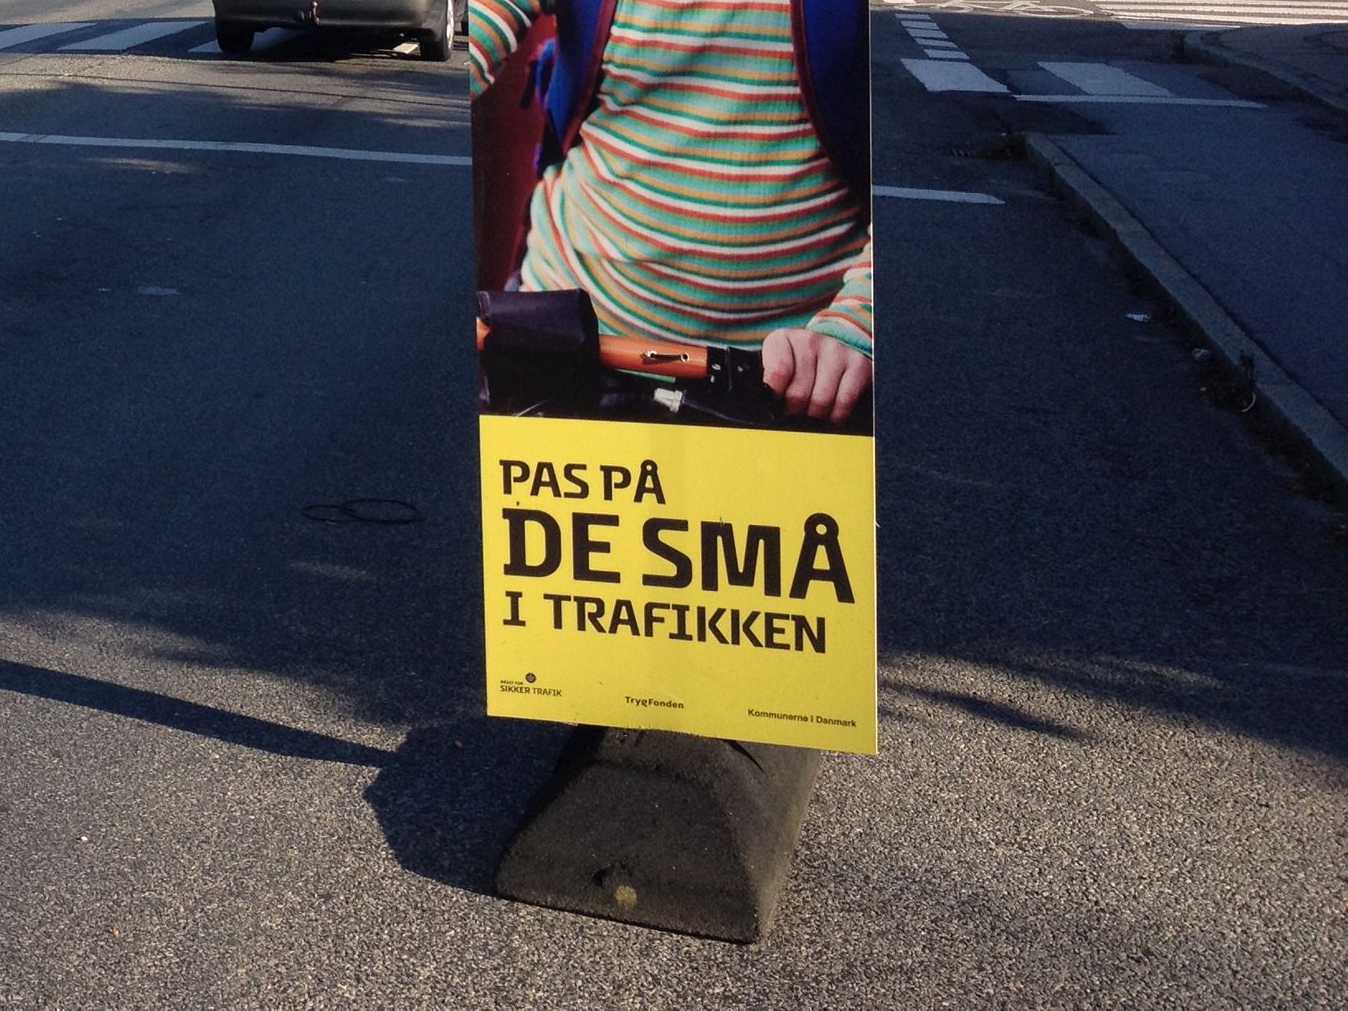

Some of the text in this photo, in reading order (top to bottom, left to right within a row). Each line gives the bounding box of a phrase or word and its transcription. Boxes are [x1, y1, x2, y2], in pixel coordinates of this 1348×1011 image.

[499, 459, 666, 505] PAS PÅ
[502, 507, 856, 604] DE SMÅ
[503, 590, 826, 654] I TRAFIKKEN
[499, 684, 563, 697] SIKKER TRAFIK
[624, 696, 685, 709] TrygFonden
[747, 708, 809, 723] Kommunerne
[816, 716, 857, 727] Danmark
